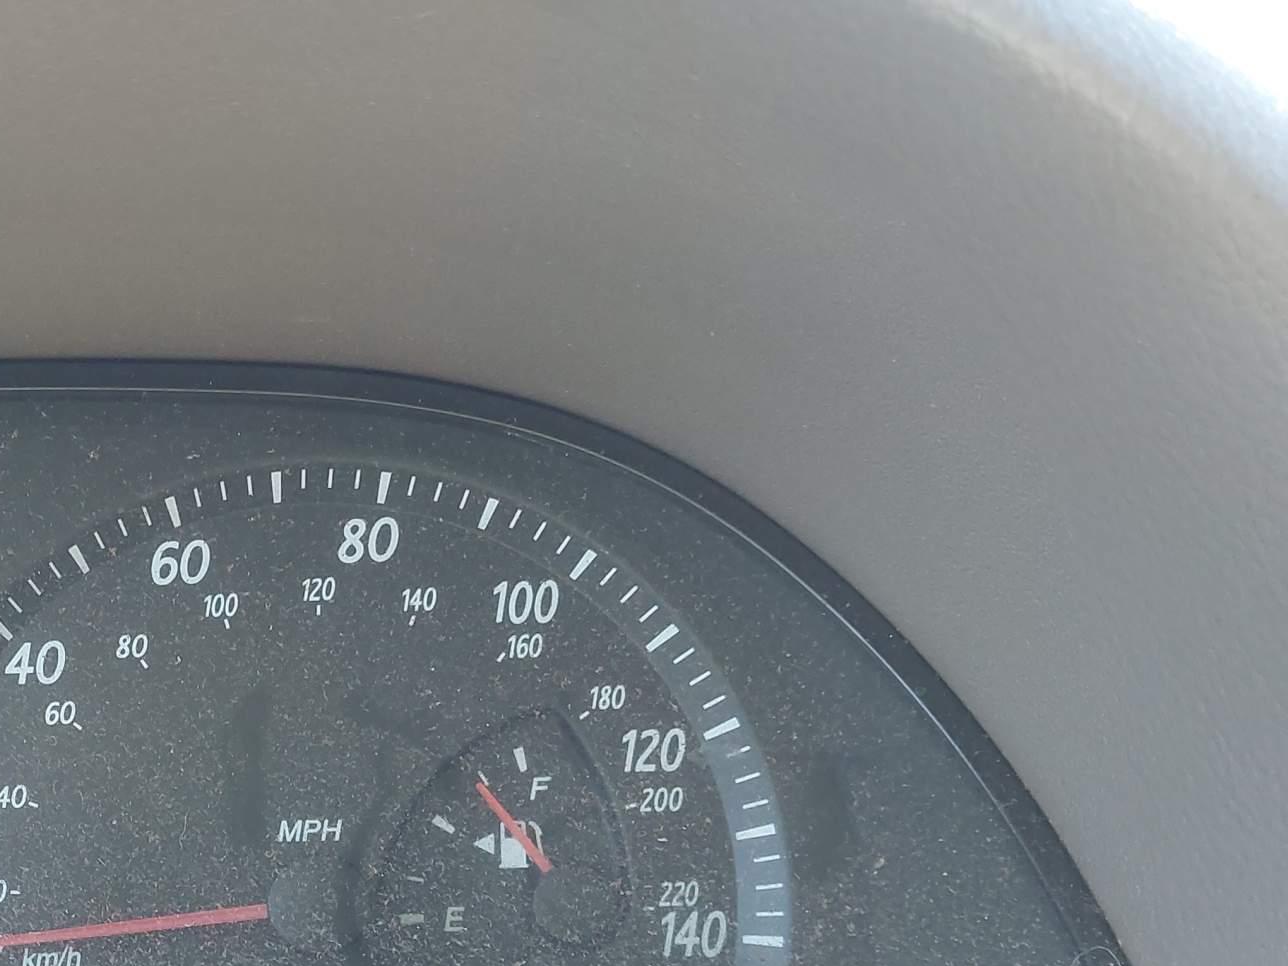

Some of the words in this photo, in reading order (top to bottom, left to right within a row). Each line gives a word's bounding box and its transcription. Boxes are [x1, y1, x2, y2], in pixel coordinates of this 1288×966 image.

[338, 517, 399, 564] 80
[151, 539, 210, 585] 60
[302, 578, 335, 602] 120
[402, 588, 437, 611] 140
[492, 580, 559, 624] 100
[204, 594, 238, 618] 100
[116, 635, 148, 658] 80
[507, 635, 542, 659] 160
[5, 641, 66, 684] 40
[590, 686, 625, 710] 180
[45, 702, 75, 726] 60
[621, 729, 685, 772] 120
[530, 777, 551, 800] F
[640, 788, 682, 812] 200
[278, 819, 342, 842] MPH
[659, 882, 698, 906] 220
[444, 907, 465, 932] E
[661, 911, 727, 958] 140
